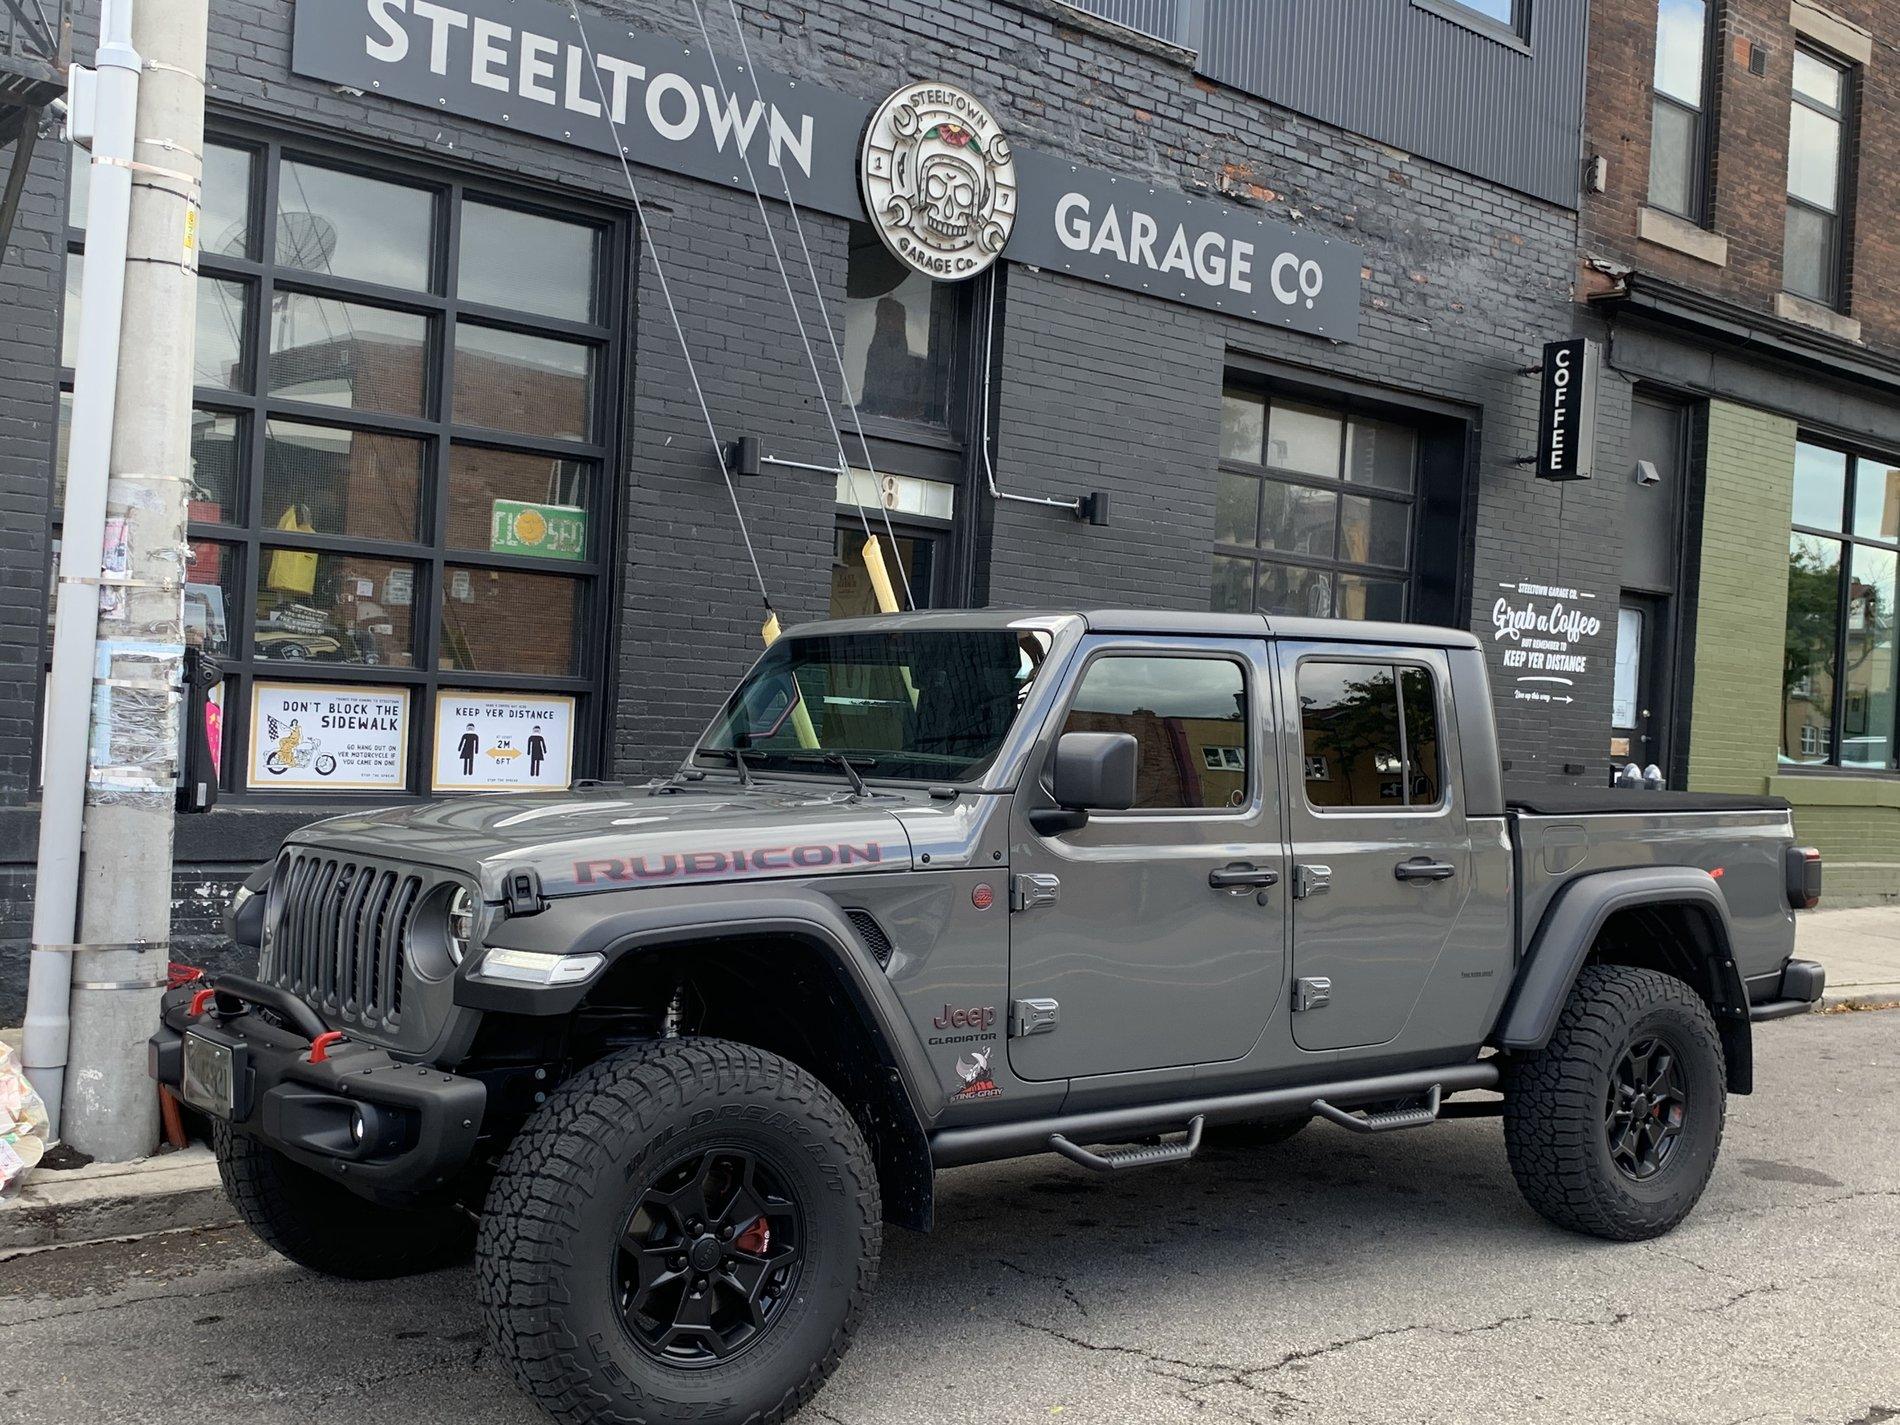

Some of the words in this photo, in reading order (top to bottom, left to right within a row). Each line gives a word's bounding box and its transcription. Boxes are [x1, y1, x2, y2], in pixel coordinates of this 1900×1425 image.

[365, 0, 814, 180] STEELTOWN
[910, 89, 988, 130] STEELTOWN
[899, 237, 952, 273] GARAGE
[1054, 192, 1254, 294] GARAGE
[1550, 349, 1570, 470] COFFEE
[1518, 583, 1548, 596] STEELTOWN
[1548, 586, 1569, 598] GARAGE
[1492, 597, 1536, 640] Grab
[1536, 615, 1549, 631] a
[1549, 603, 1600, 642] Coffee
[1521, 638, 1532, 648] BUT
[1532, 639, 1559, 650] REMEMBER
[1560, 641, 1567, 652] TO
[1503, 649, 1527, 667] KEEP
[1528, 652, 1544, 669] YER
[1545, 653, 1587, 673] DISTANCE
[283, 701, 321, 713] DON'T
[329, 703, 368, 715] BLOCK
[376, 705, 399, 716] THE
[455, 707, 480, 717] KEEP
[486, 708, 504, 718] YER
[509, 709, 554, 720] DISTANCE
[321, 715, 398, 731] SIDEWALK
[351, 751, 388, 759] MOTORCYCLE
[497, 740, 510, 749] 2M
[573, 842, 881, 884] RUBICON
[934, 1003, 996, 1031] Jeep
[928, 1032, 997, 1046] GLADIATOR
[624, 1104, 812, 1182] WILDPEAK
